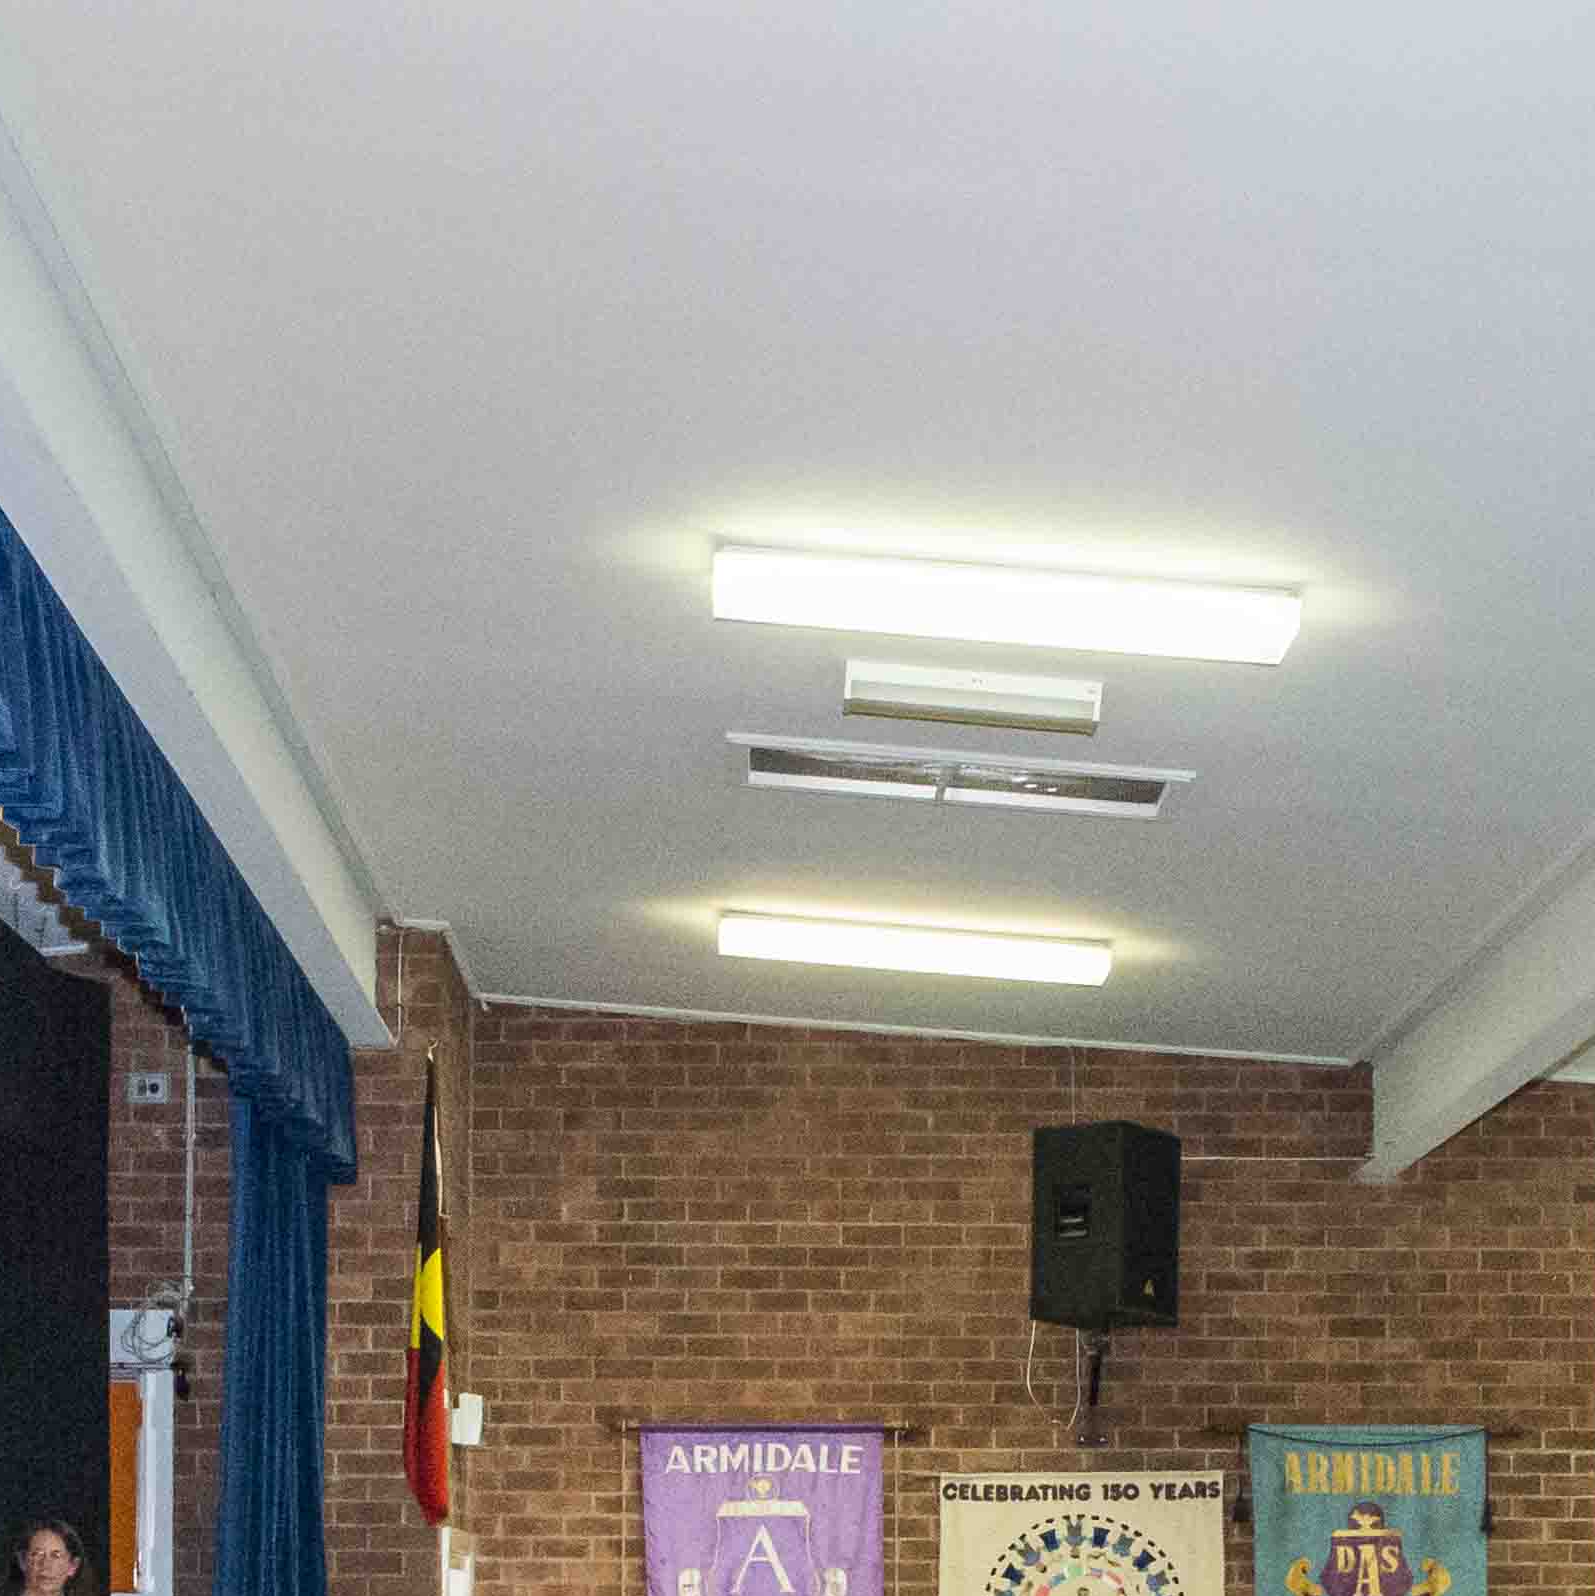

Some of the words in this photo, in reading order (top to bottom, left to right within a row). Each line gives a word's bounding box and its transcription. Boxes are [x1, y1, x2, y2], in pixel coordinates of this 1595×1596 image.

[666, 1443, 864, 1474] ARMIDALE
[1284, 1451, 1461, 1496] ARMIDALE
[942, 1482, 1091, 1502] CELEBRATING
[1101, 1483, 1140, 1501] 150
[1149, 1481, 1221, 1500] YEARS
[731, 1524, 796, 1593] A
